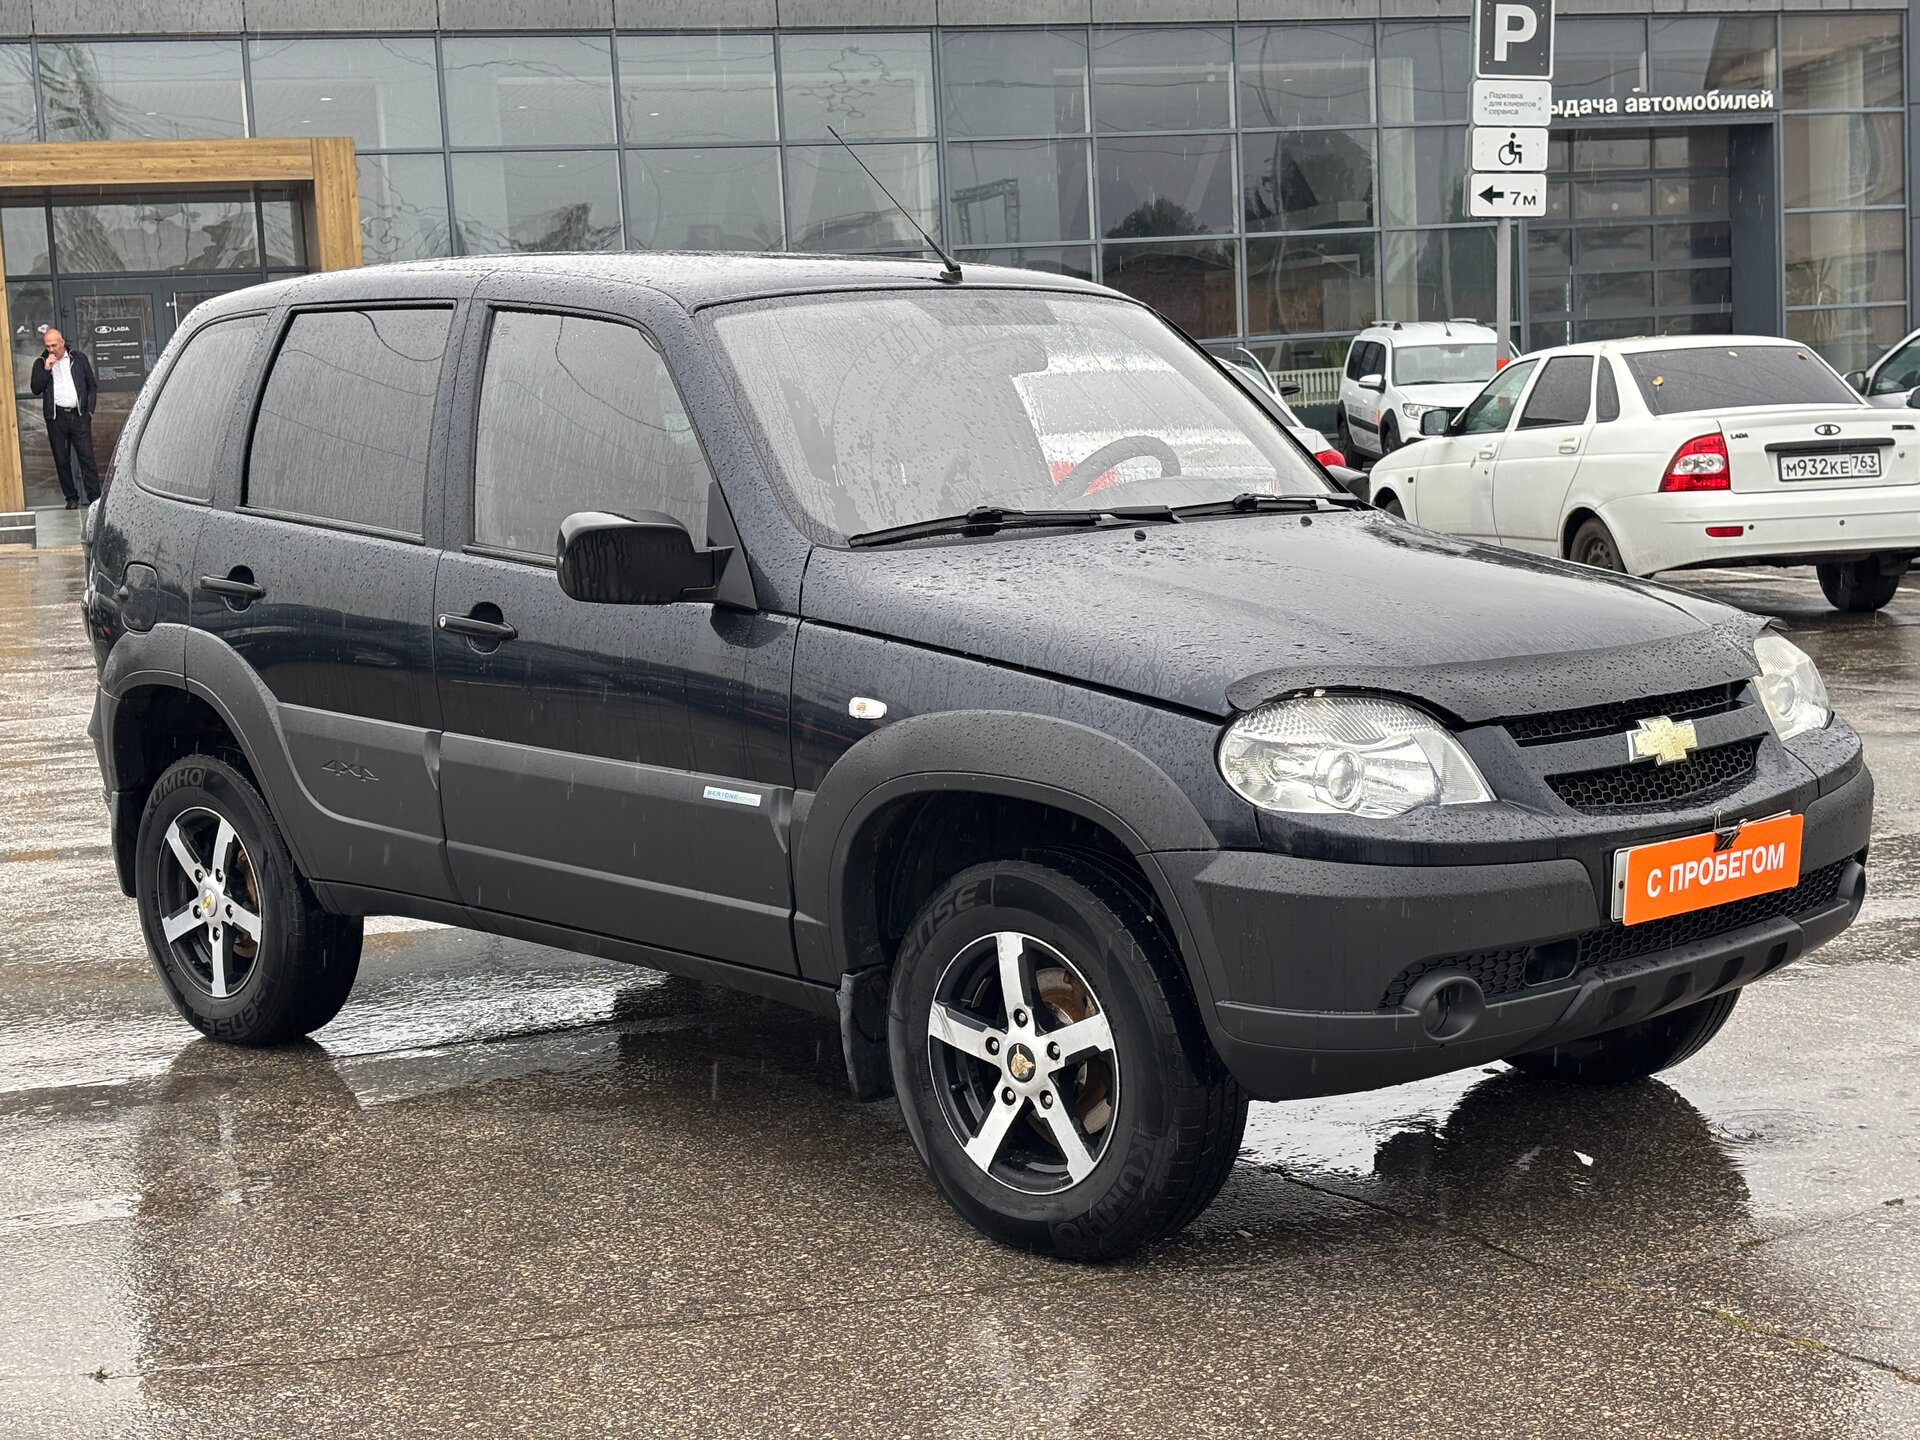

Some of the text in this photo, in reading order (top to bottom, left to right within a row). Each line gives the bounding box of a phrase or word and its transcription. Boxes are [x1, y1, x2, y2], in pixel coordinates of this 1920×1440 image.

[1493, 3, 1538, 62] P
[1489, 91, 1524, 99] Парковка
[1551, 90, 1774, 117] ыдача автомобилей
[1851, 455, 1877, 469] 763
[1646, 842, 1786, 898] С ПРОБЕГОМ
